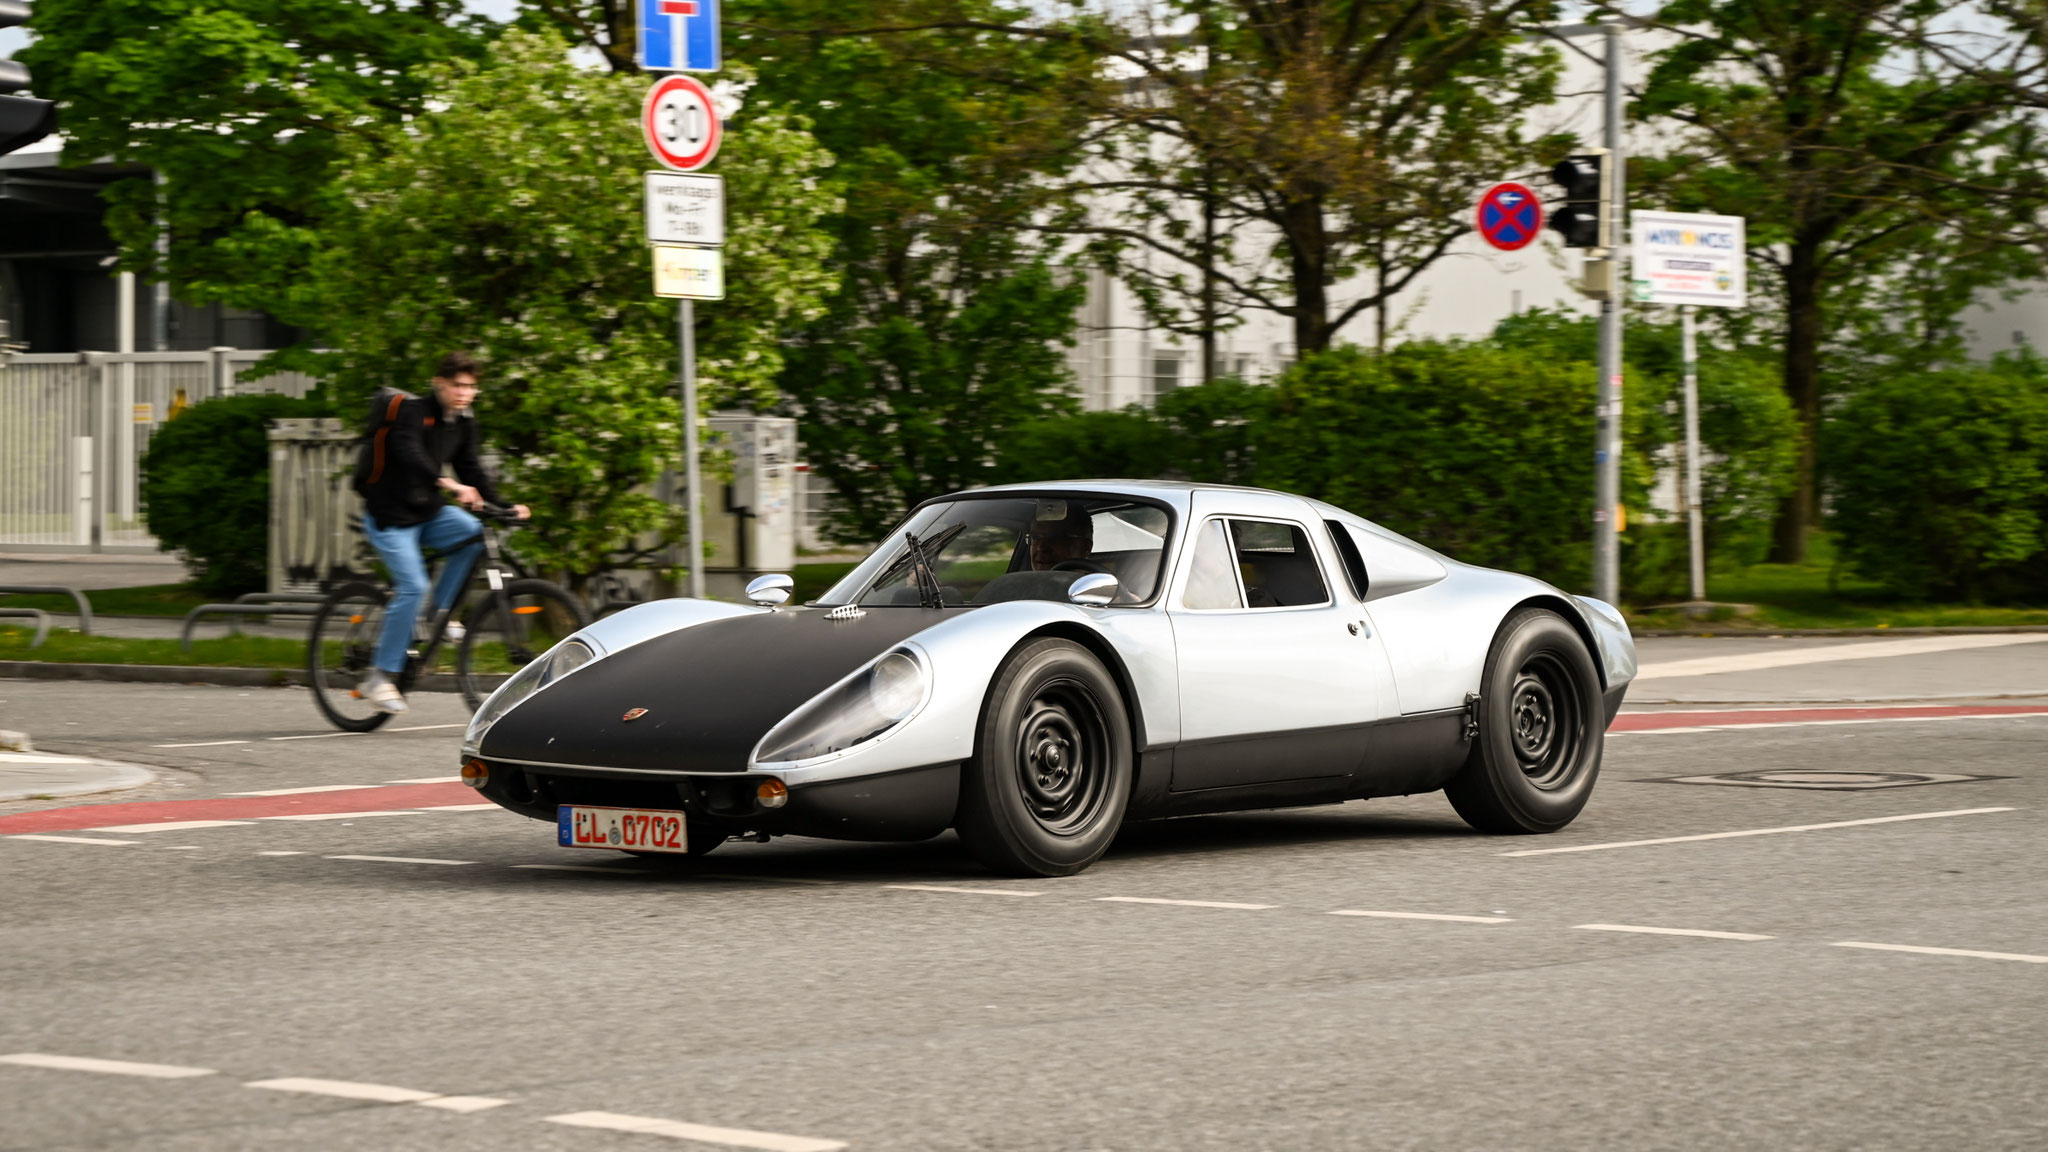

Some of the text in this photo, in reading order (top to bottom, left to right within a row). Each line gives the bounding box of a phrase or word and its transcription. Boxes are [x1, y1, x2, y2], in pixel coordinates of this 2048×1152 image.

[661, 104, 704, 143] 30
[576, 812, 682, 848] LL 0702
